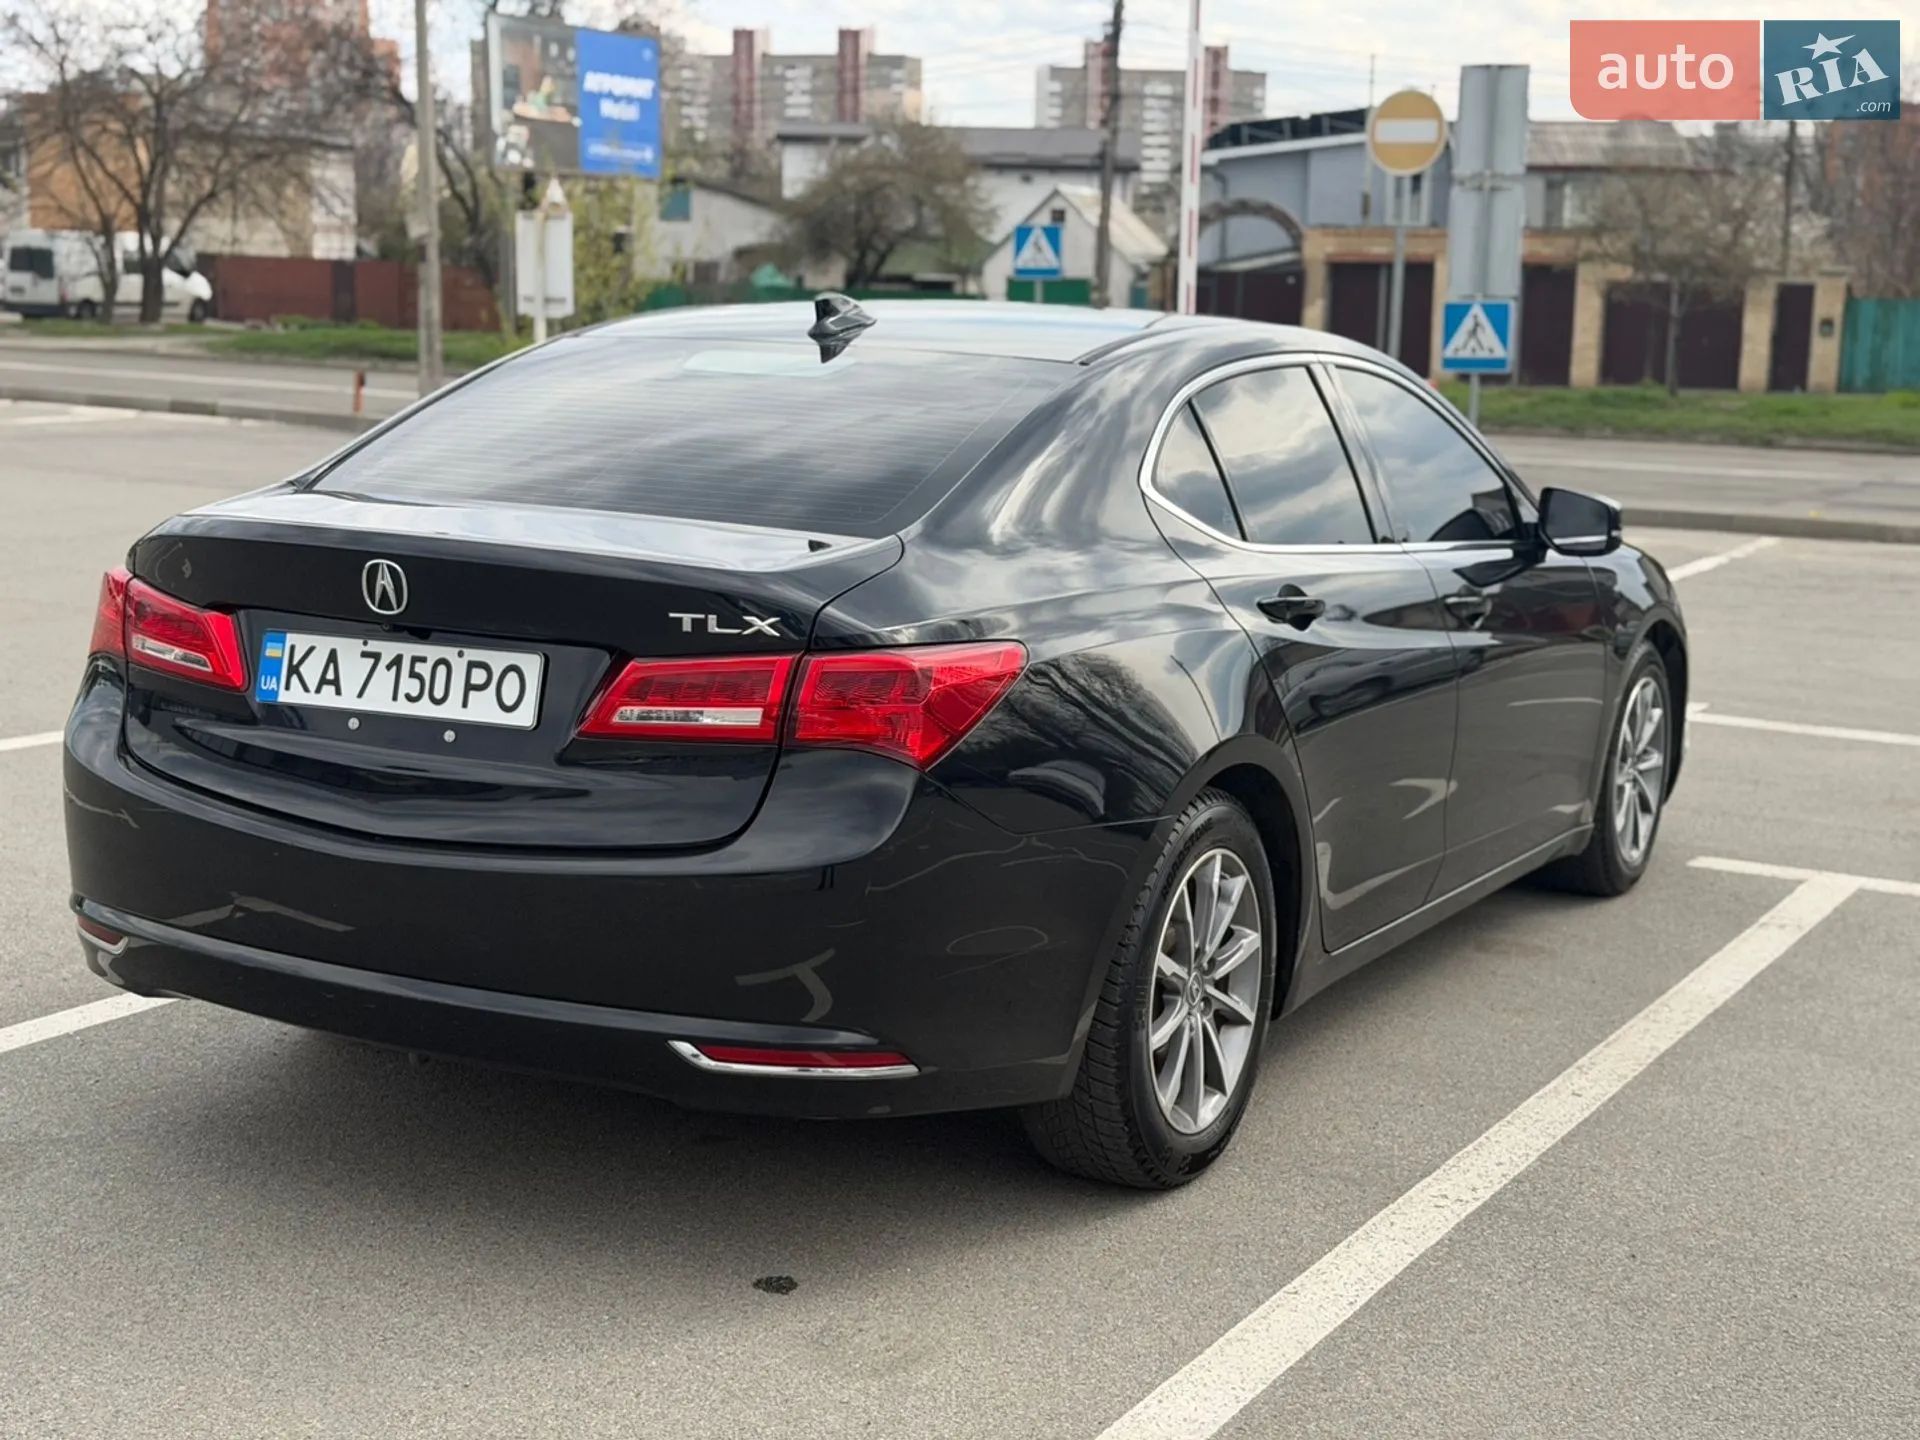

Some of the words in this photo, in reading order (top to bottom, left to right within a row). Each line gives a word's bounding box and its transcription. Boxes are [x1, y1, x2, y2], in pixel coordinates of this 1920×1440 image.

[668, 612, 780, 637] TLX
[260, 675, 278, 691] UA
[284, 644, 342, 697] KA
[356, 650, 453, 706] 7150
[461, 659, 526, 713] PO
